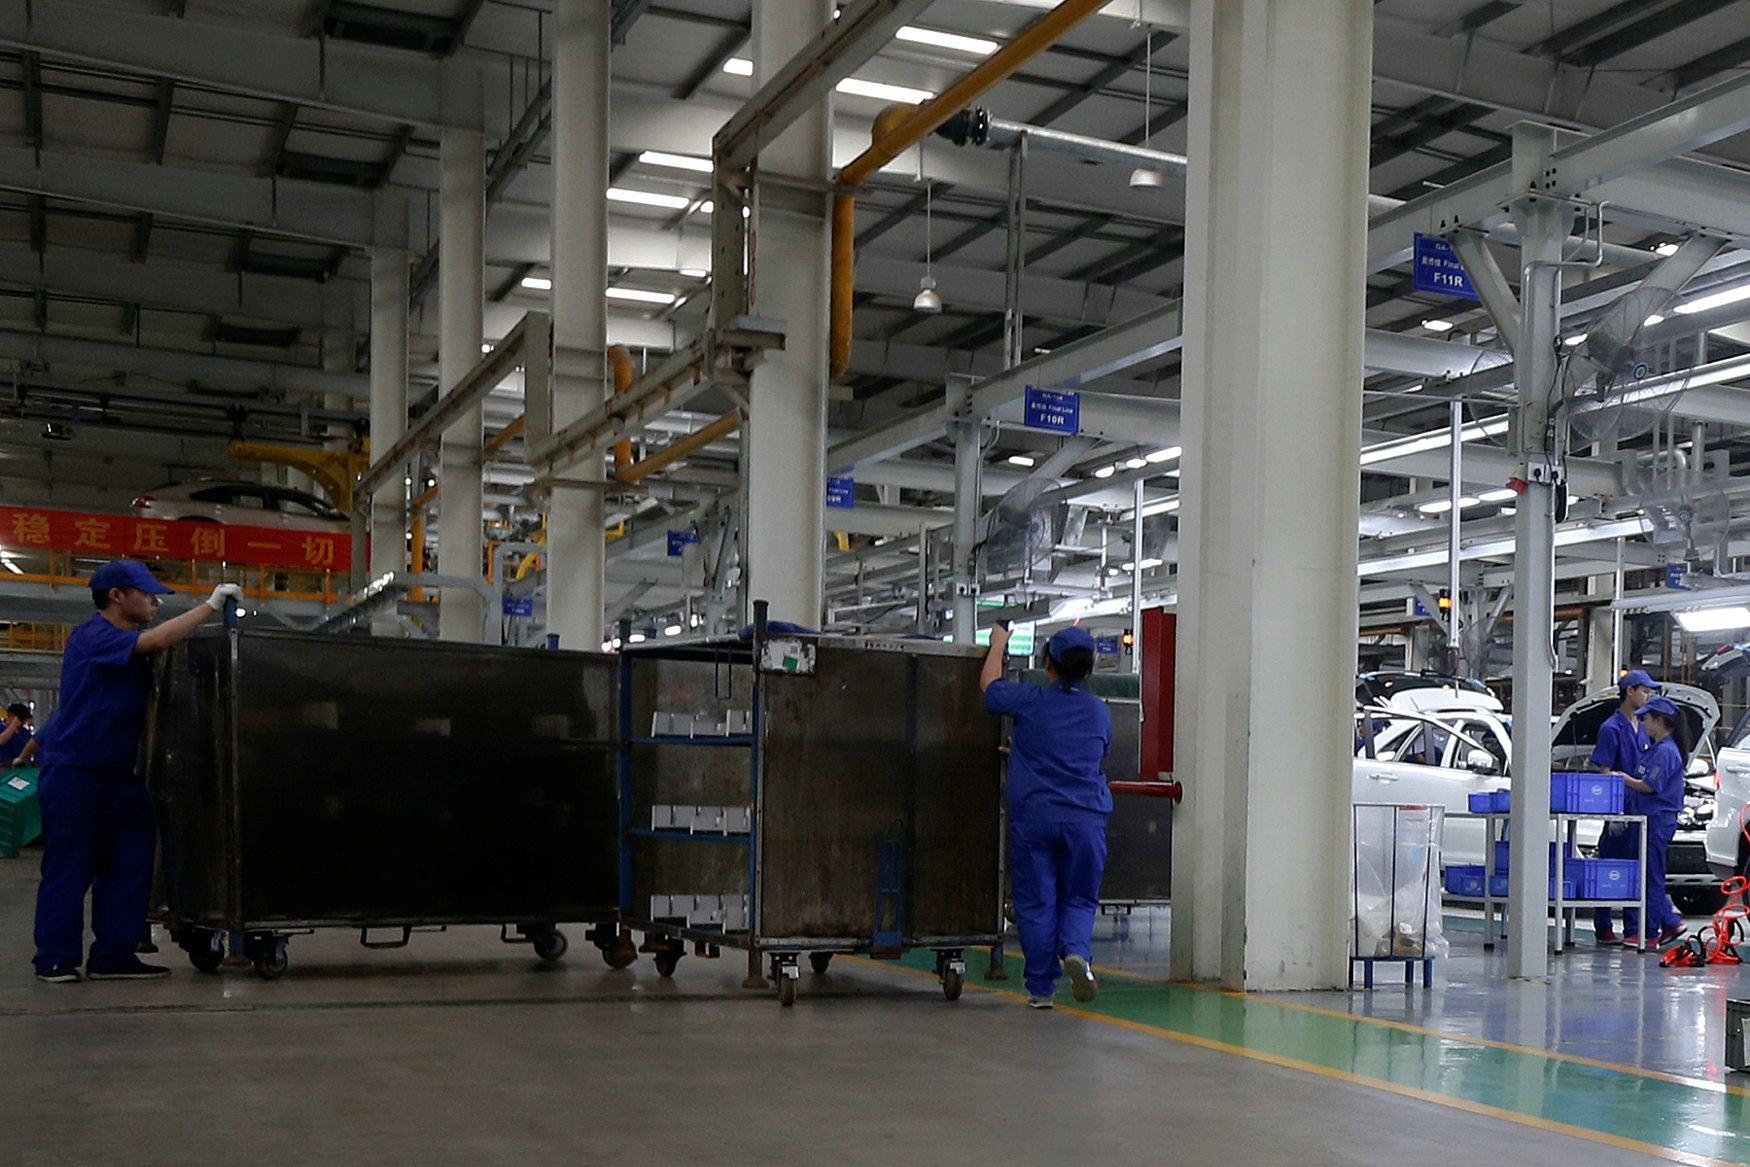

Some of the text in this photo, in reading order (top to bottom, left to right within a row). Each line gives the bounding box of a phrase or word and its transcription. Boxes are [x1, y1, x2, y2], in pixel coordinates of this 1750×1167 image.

[1433, 272, 1463, 287] F11R
[1041, 413, 1064, 425] F10R
[13, 511, 335, 565] 稳定压倒一切
